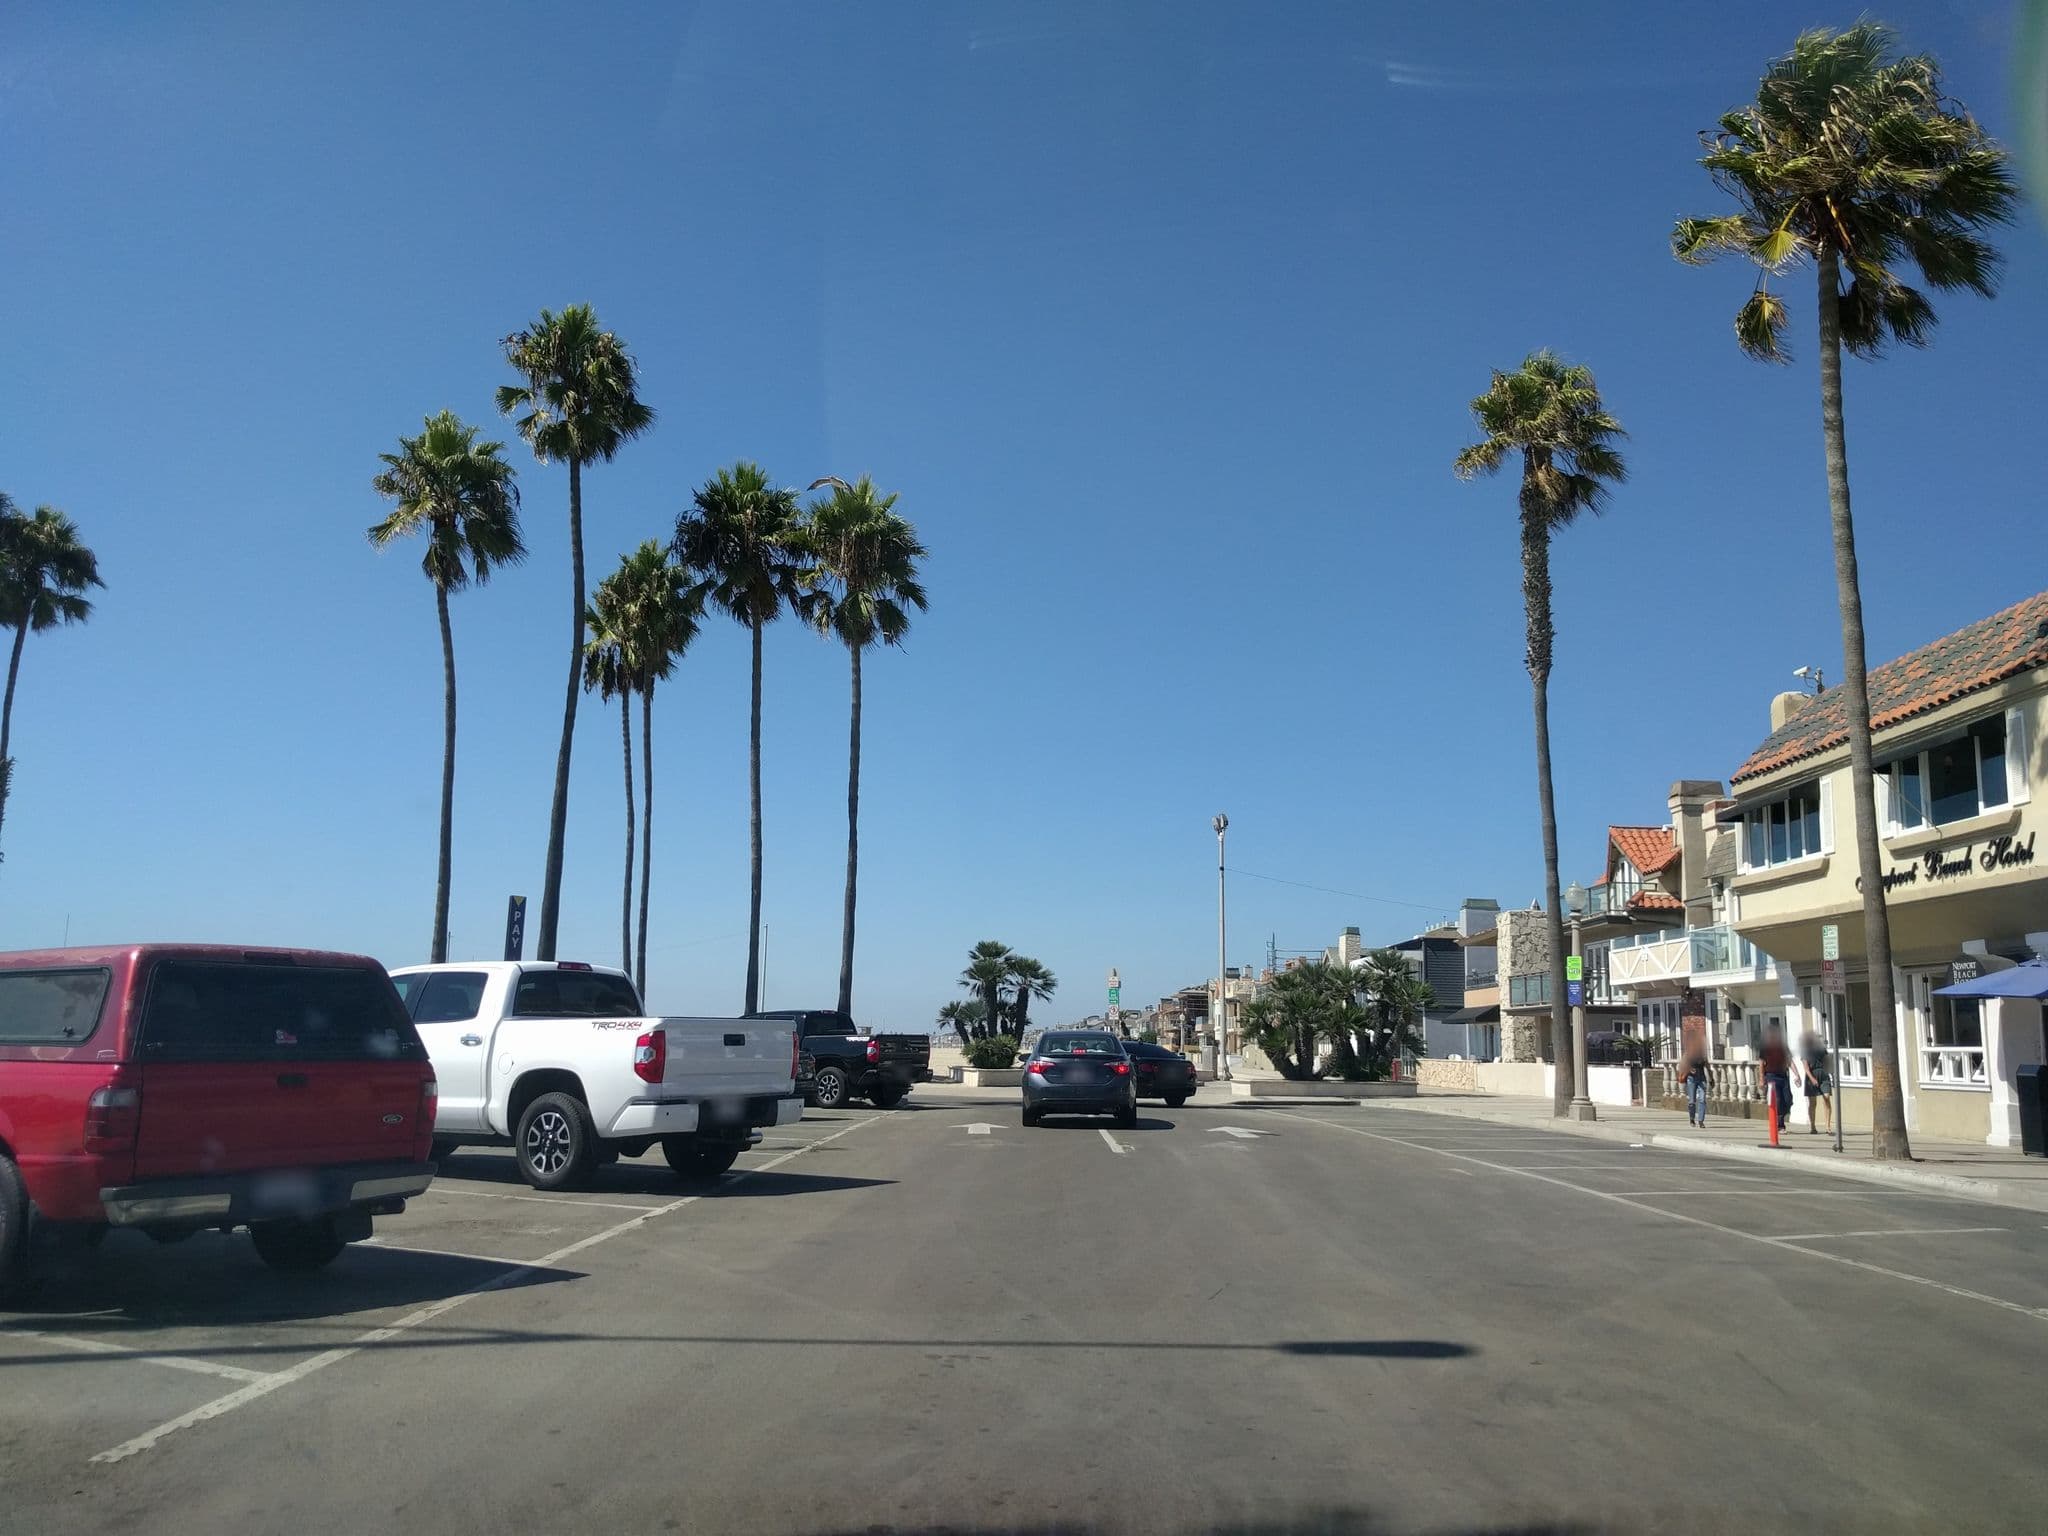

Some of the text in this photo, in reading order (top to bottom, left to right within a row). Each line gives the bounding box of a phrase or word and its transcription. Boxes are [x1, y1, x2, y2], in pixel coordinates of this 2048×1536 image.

[1923, 846, 1972, 879] Beach
[1980, 832, 2034, 869] Hotel
[512, 910, 521, 948] PAY
[1952, 961, 1976, 970] NEWPORT
[1953, 970, 1977, 978] BEACH
